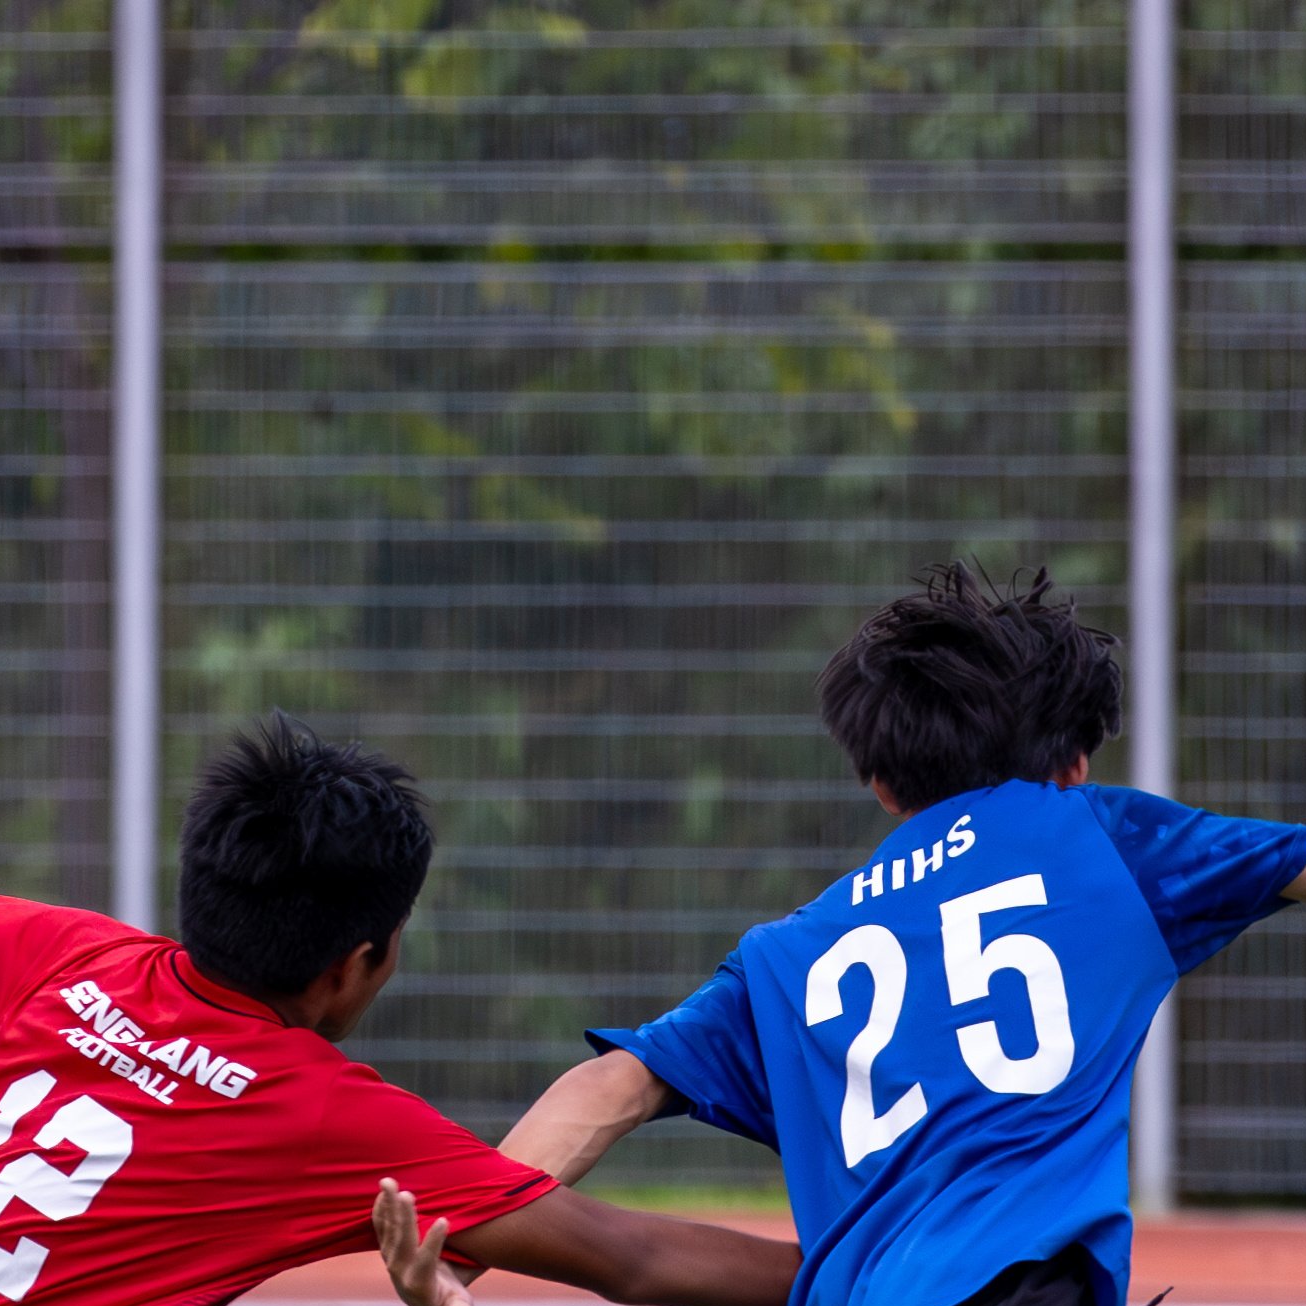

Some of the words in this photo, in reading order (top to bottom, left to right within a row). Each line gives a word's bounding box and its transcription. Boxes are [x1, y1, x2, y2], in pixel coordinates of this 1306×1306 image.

[851, 814, 977, 906] HIHS
[58, 1027, 180, 1106] FOOTBALL
[59, 979, 258, 1099] SENGANG
[805, 873, 1076, 1169] 25
